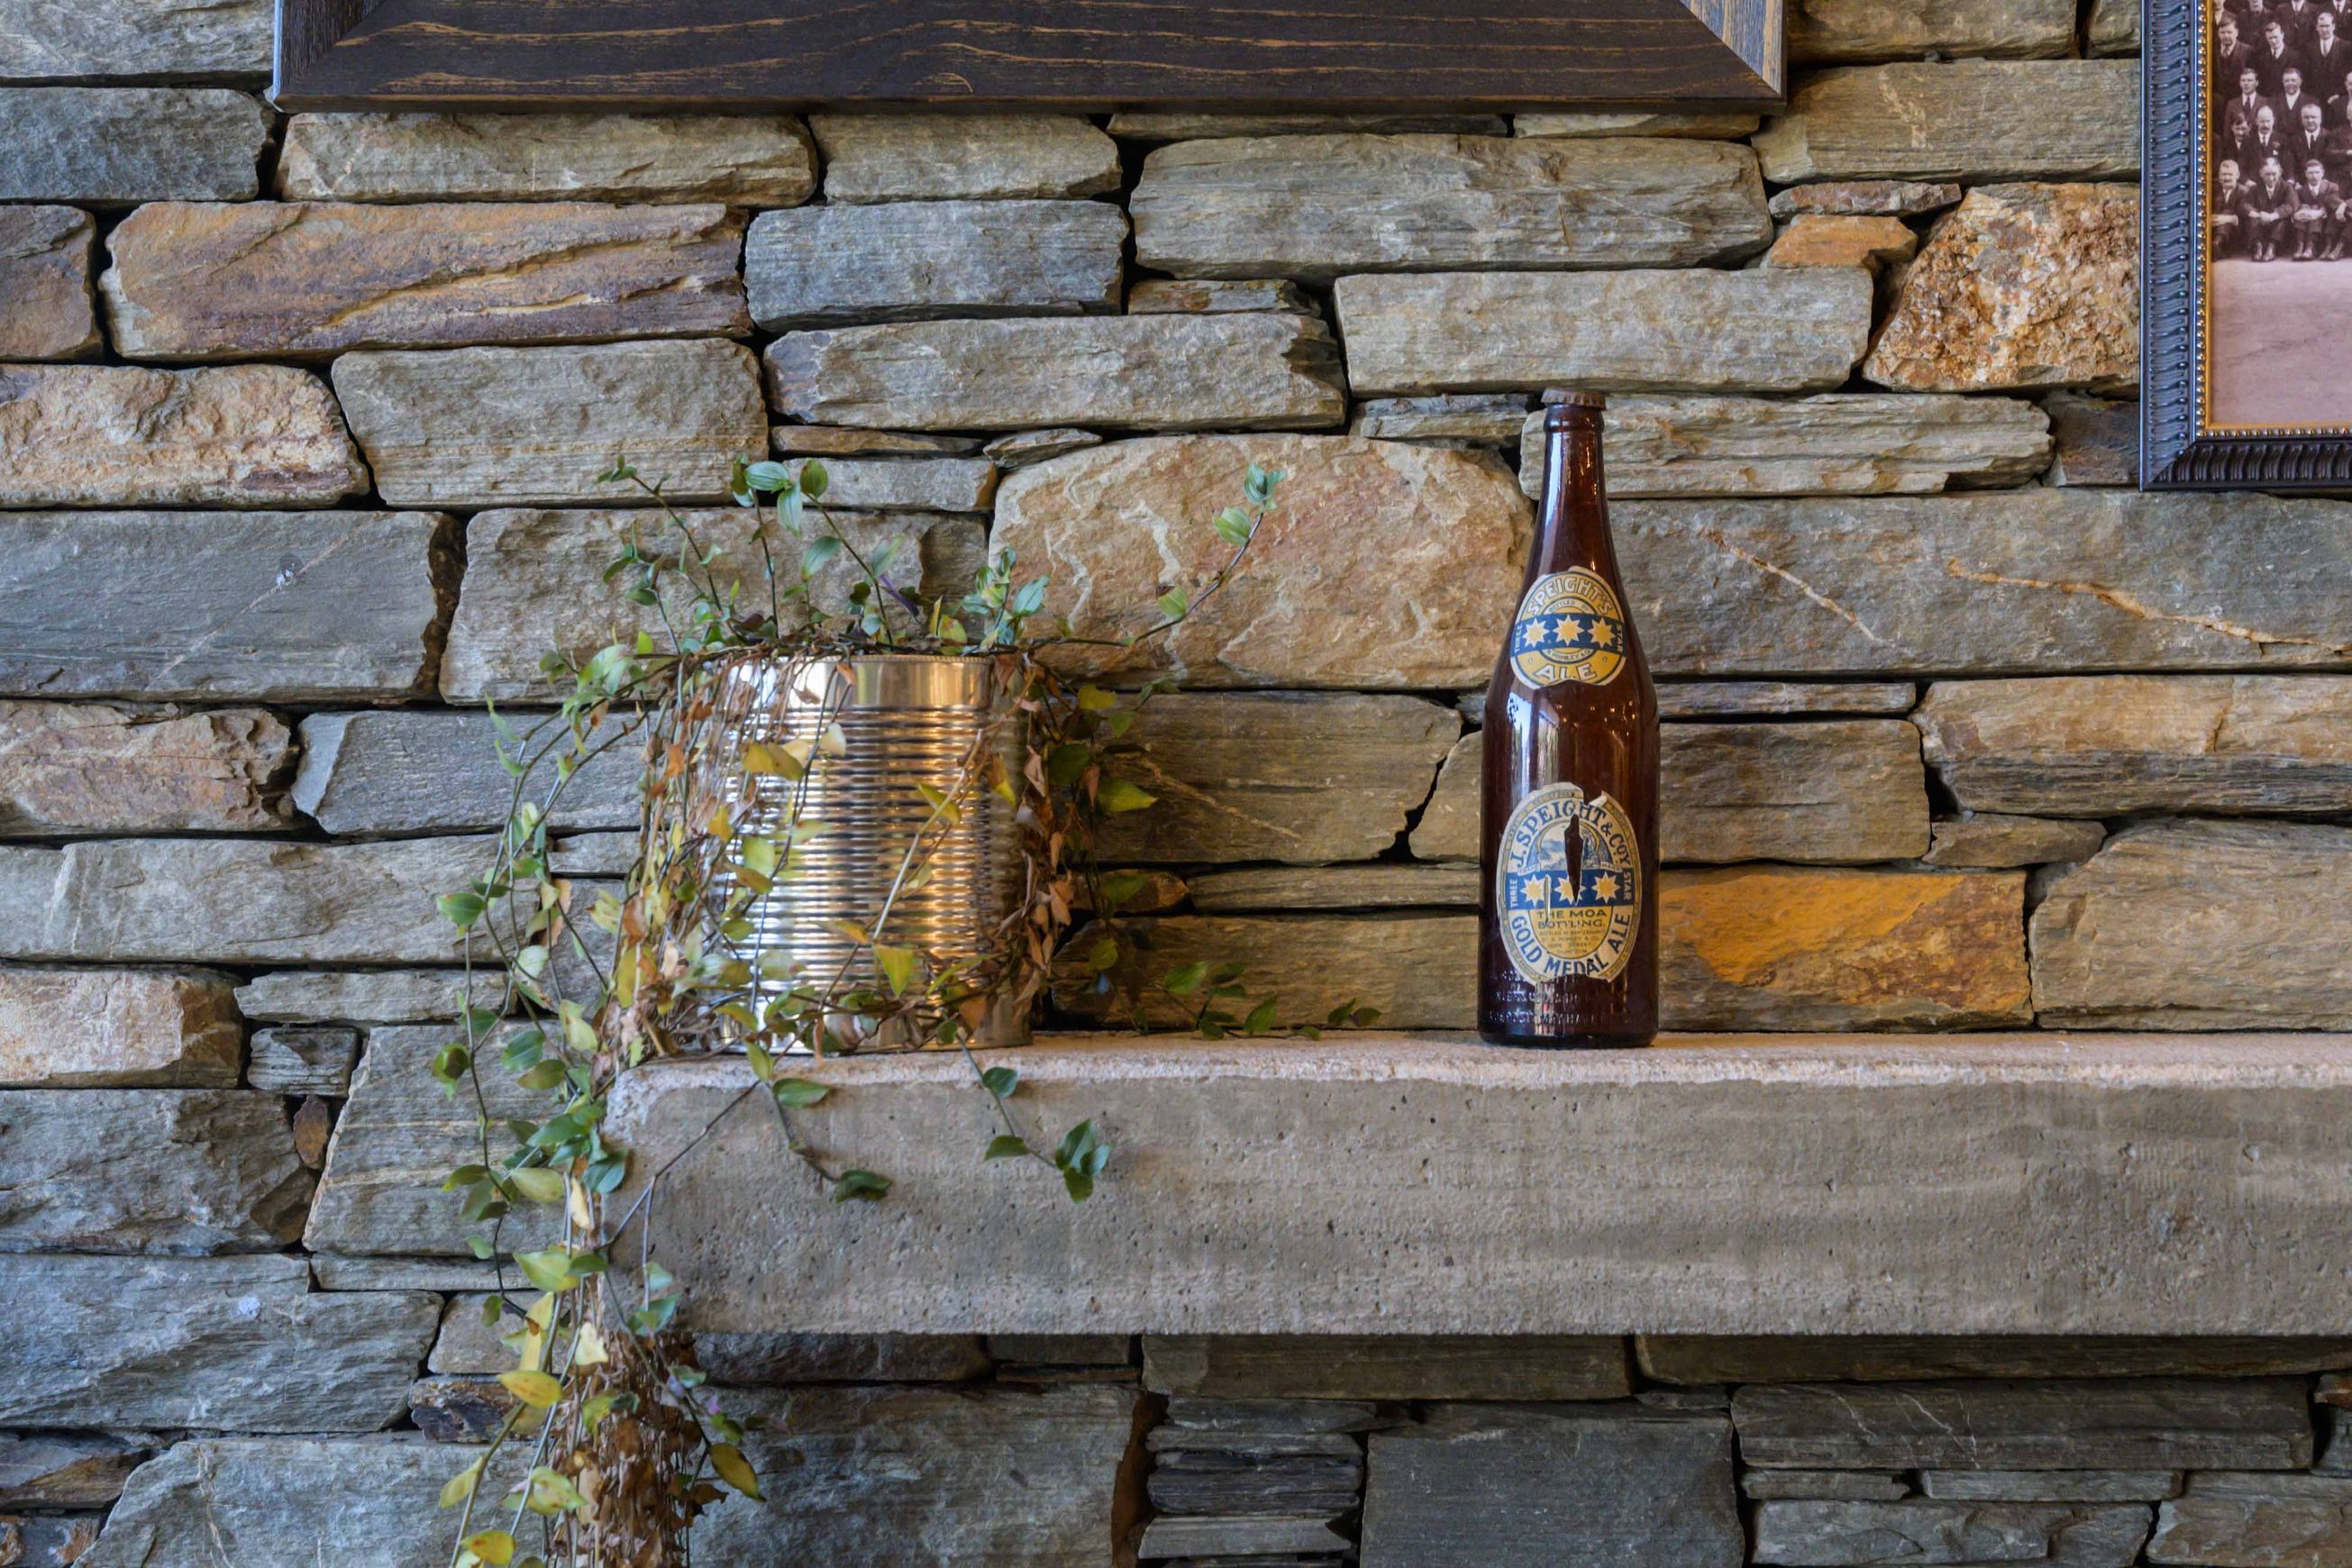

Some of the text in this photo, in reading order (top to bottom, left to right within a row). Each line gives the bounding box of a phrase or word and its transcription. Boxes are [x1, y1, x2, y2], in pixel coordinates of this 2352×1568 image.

[1527, 577, 1613, 616] SPEIGHT'S
[1515, 624, 1523, 653] THREE
[1533, 662, 1597, 682] ALE
[1600, 822, 1612, 836] &
[1509, 879, 1518, 907] THREE
[1623, 871, 1632, 900] STAR
[1537, 909, 1607, 918] THE MOA
[1511, 913, 1630, 976] GOLD MEDAL ALE
